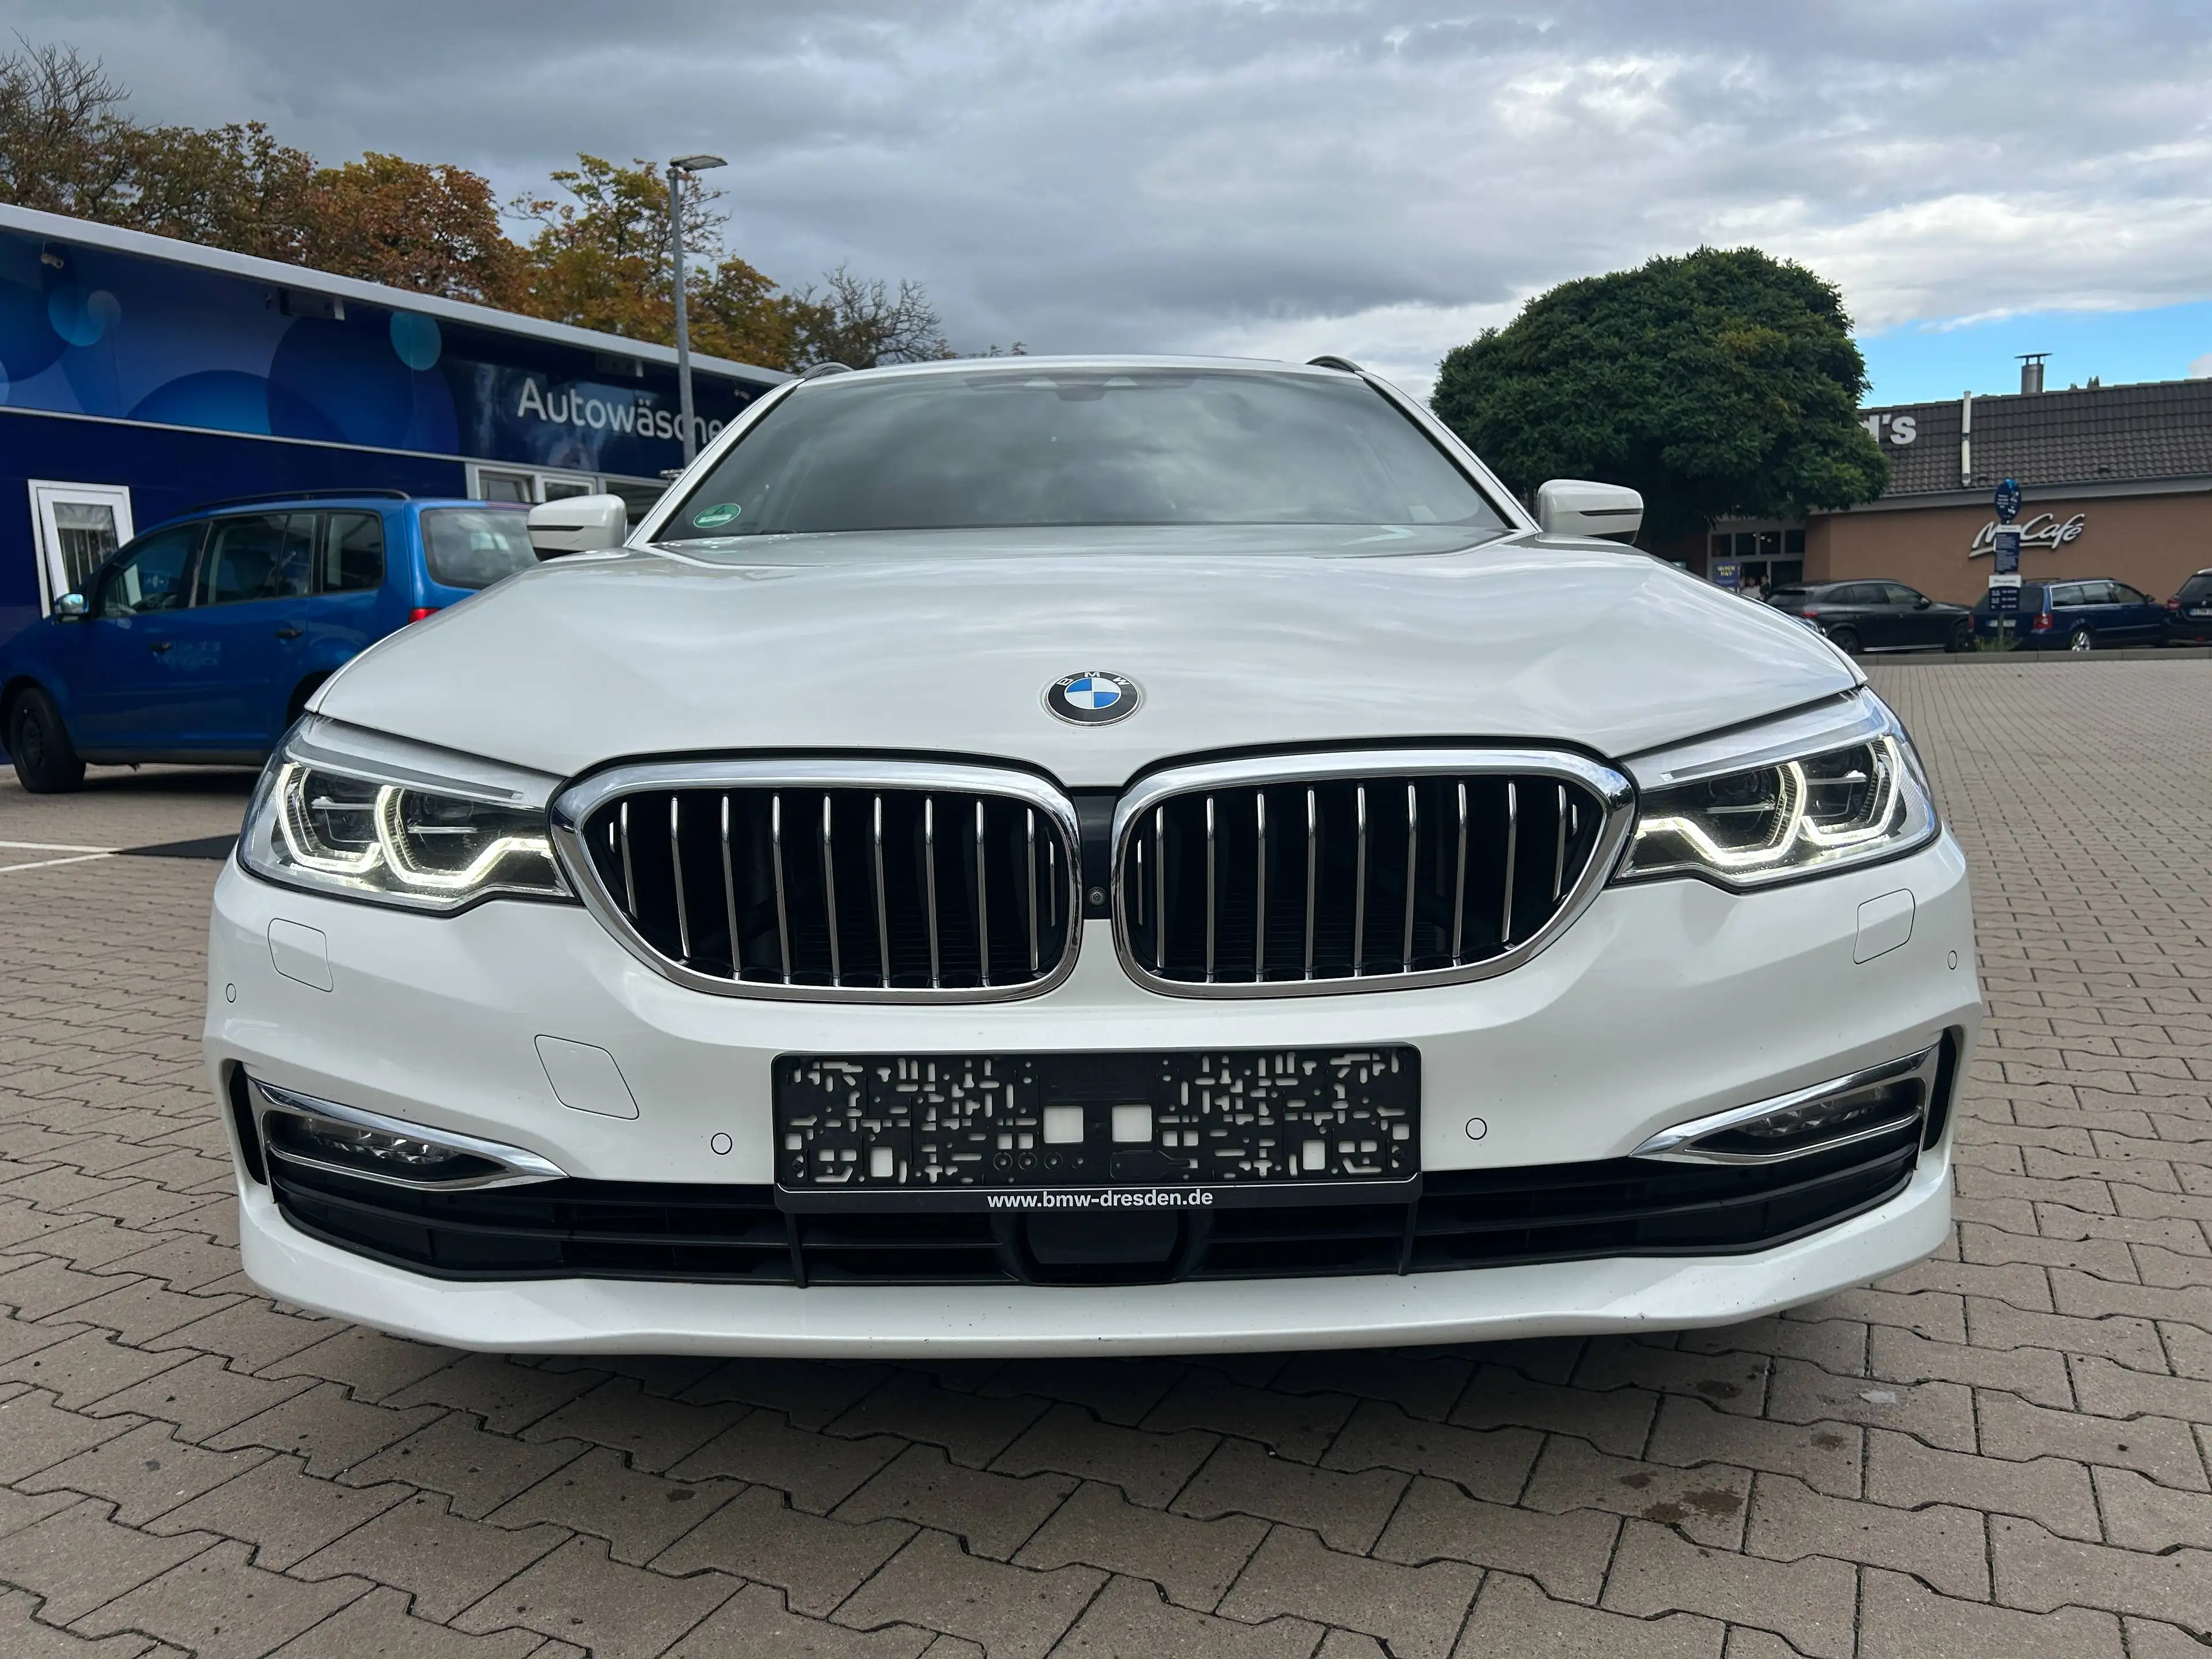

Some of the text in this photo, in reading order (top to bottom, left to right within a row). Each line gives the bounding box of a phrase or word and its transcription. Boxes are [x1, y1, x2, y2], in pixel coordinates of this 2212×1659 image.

[1970, 512, 2085, 553] MCafé
[1056, 672, 1130, 687] BMW
[987, 1189, 1213, 1207] www.bmw-dresden.de
